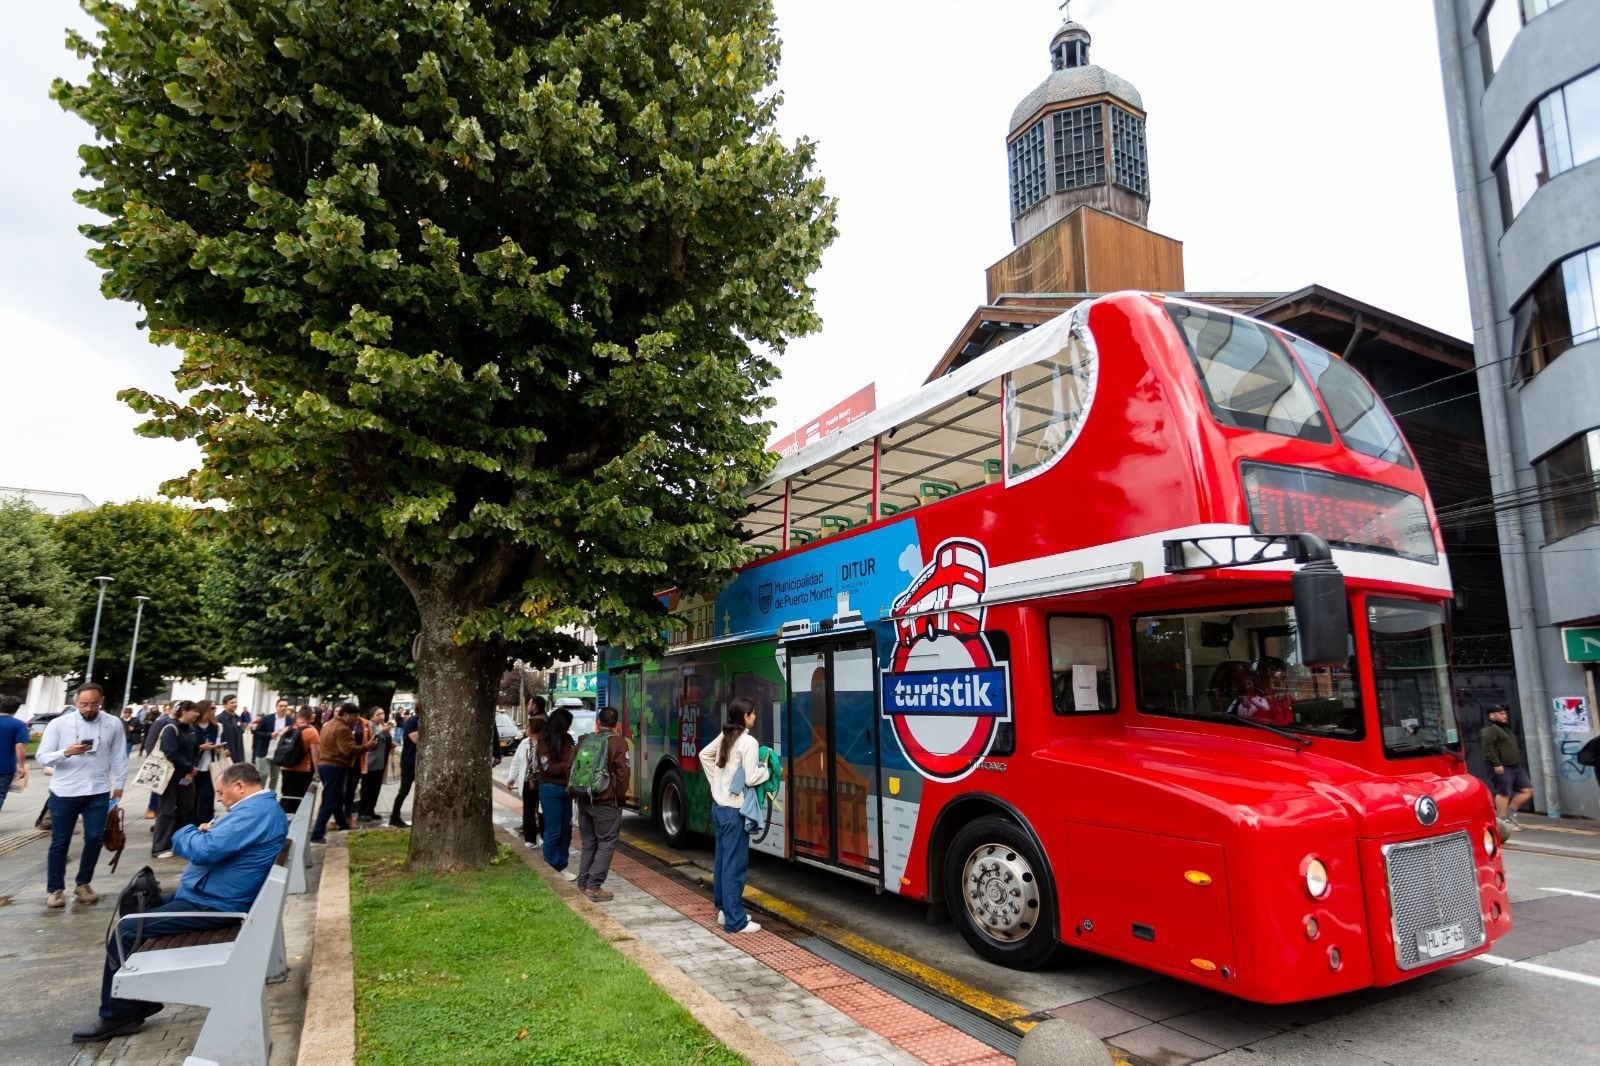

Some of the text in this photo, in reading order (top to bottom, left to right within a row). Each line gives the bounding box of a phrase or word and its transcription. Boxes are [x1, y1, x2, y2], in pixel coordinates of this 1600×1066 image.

[841, 557, 876, 581] DITUR
[774, 569, 824, 594] Municipalidad
[775, 598, 784, 609] de
[784, 592, 809, 608] Puerto
[809, 585, 833, 604] Montt
[894, 674, 993, 707] turistik
